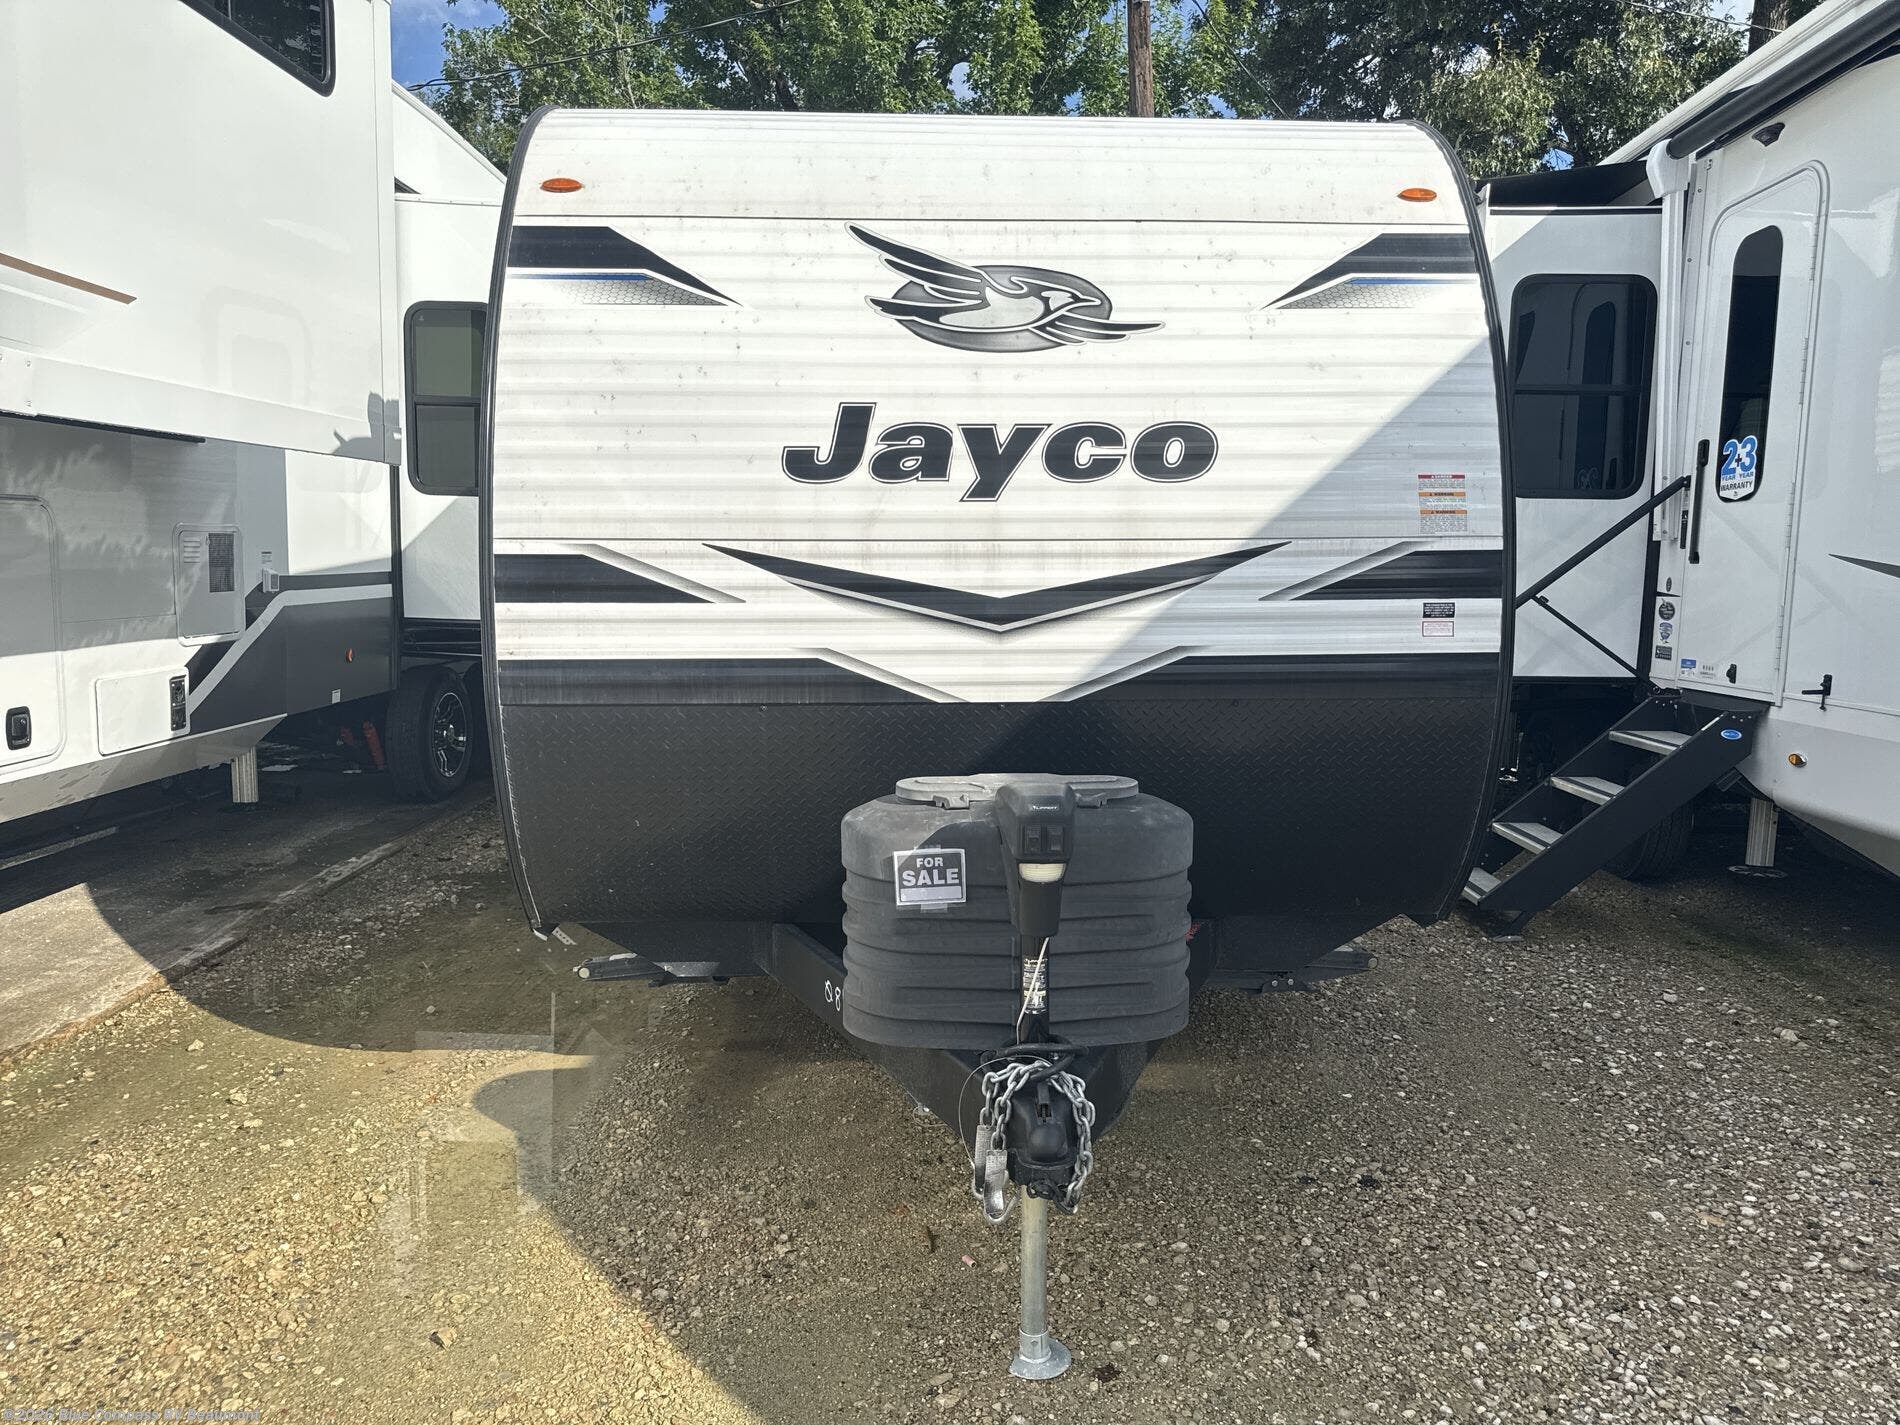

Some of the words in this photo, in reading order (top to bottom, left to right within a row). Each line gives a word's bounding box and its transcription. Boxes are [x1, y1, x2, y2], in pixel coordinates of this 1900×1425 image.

[781, 402, 1219, 502] Jayco
[1720, 481, 1754, 491] WARRANTY
[916, 857, 944, 868] FOR
[902, 868, 960, 886] SALE
